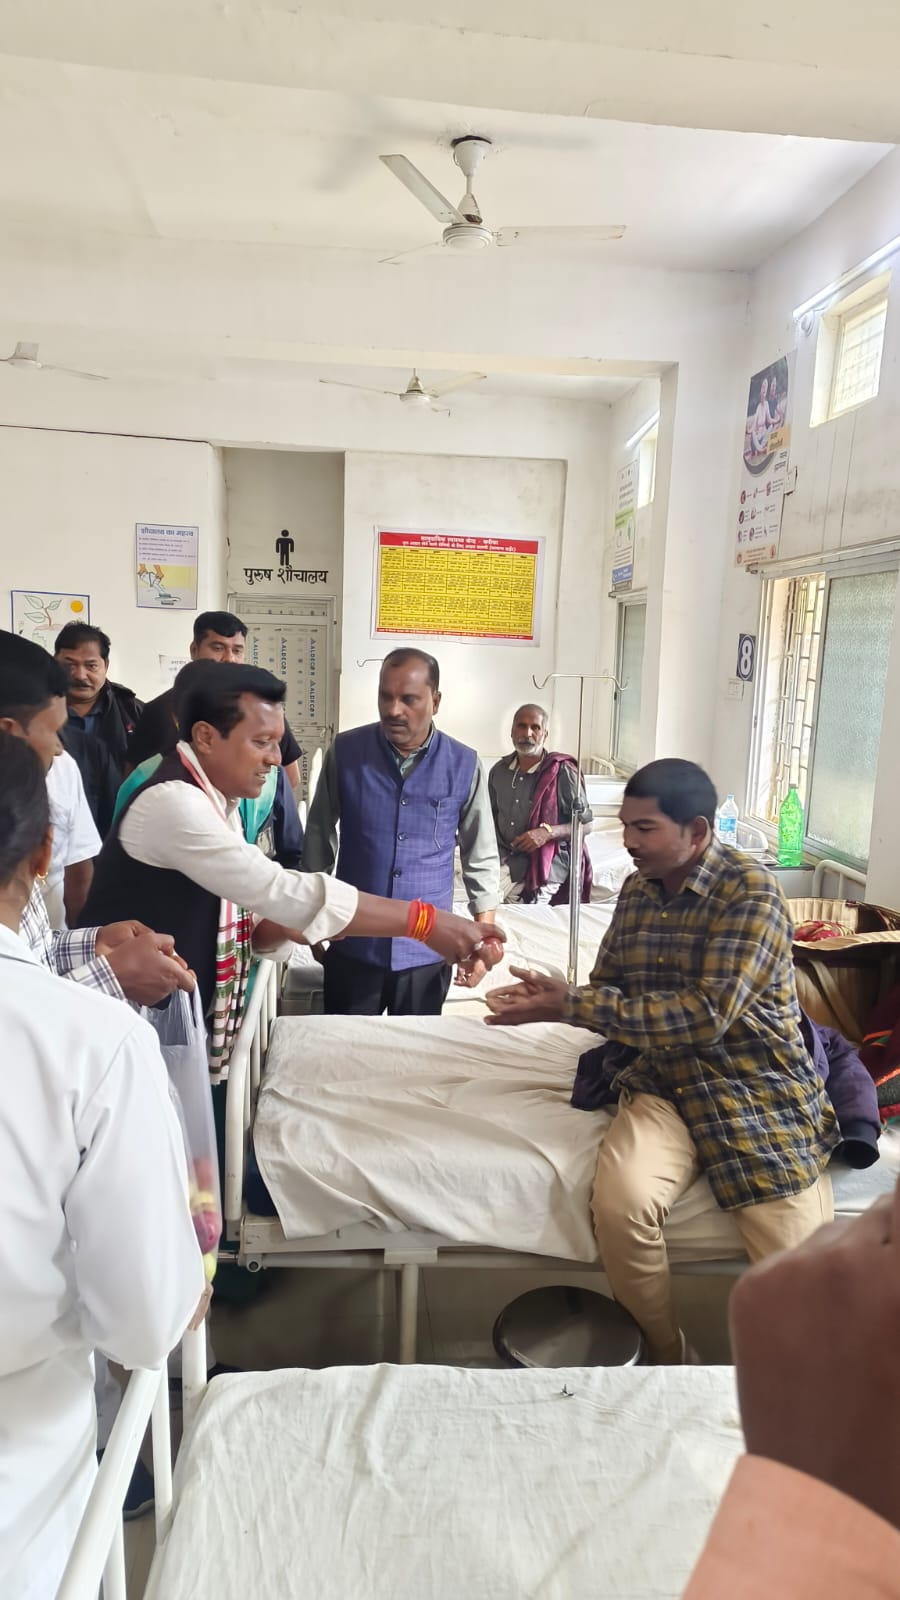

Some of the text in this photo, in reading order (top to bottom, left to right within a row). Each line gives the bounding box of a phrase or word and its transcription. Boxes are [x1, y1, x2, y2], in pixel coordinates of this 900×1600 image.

[243, 564, 328, 586] पुरुष शौचालय
[740, 639, 753, 676] 8
